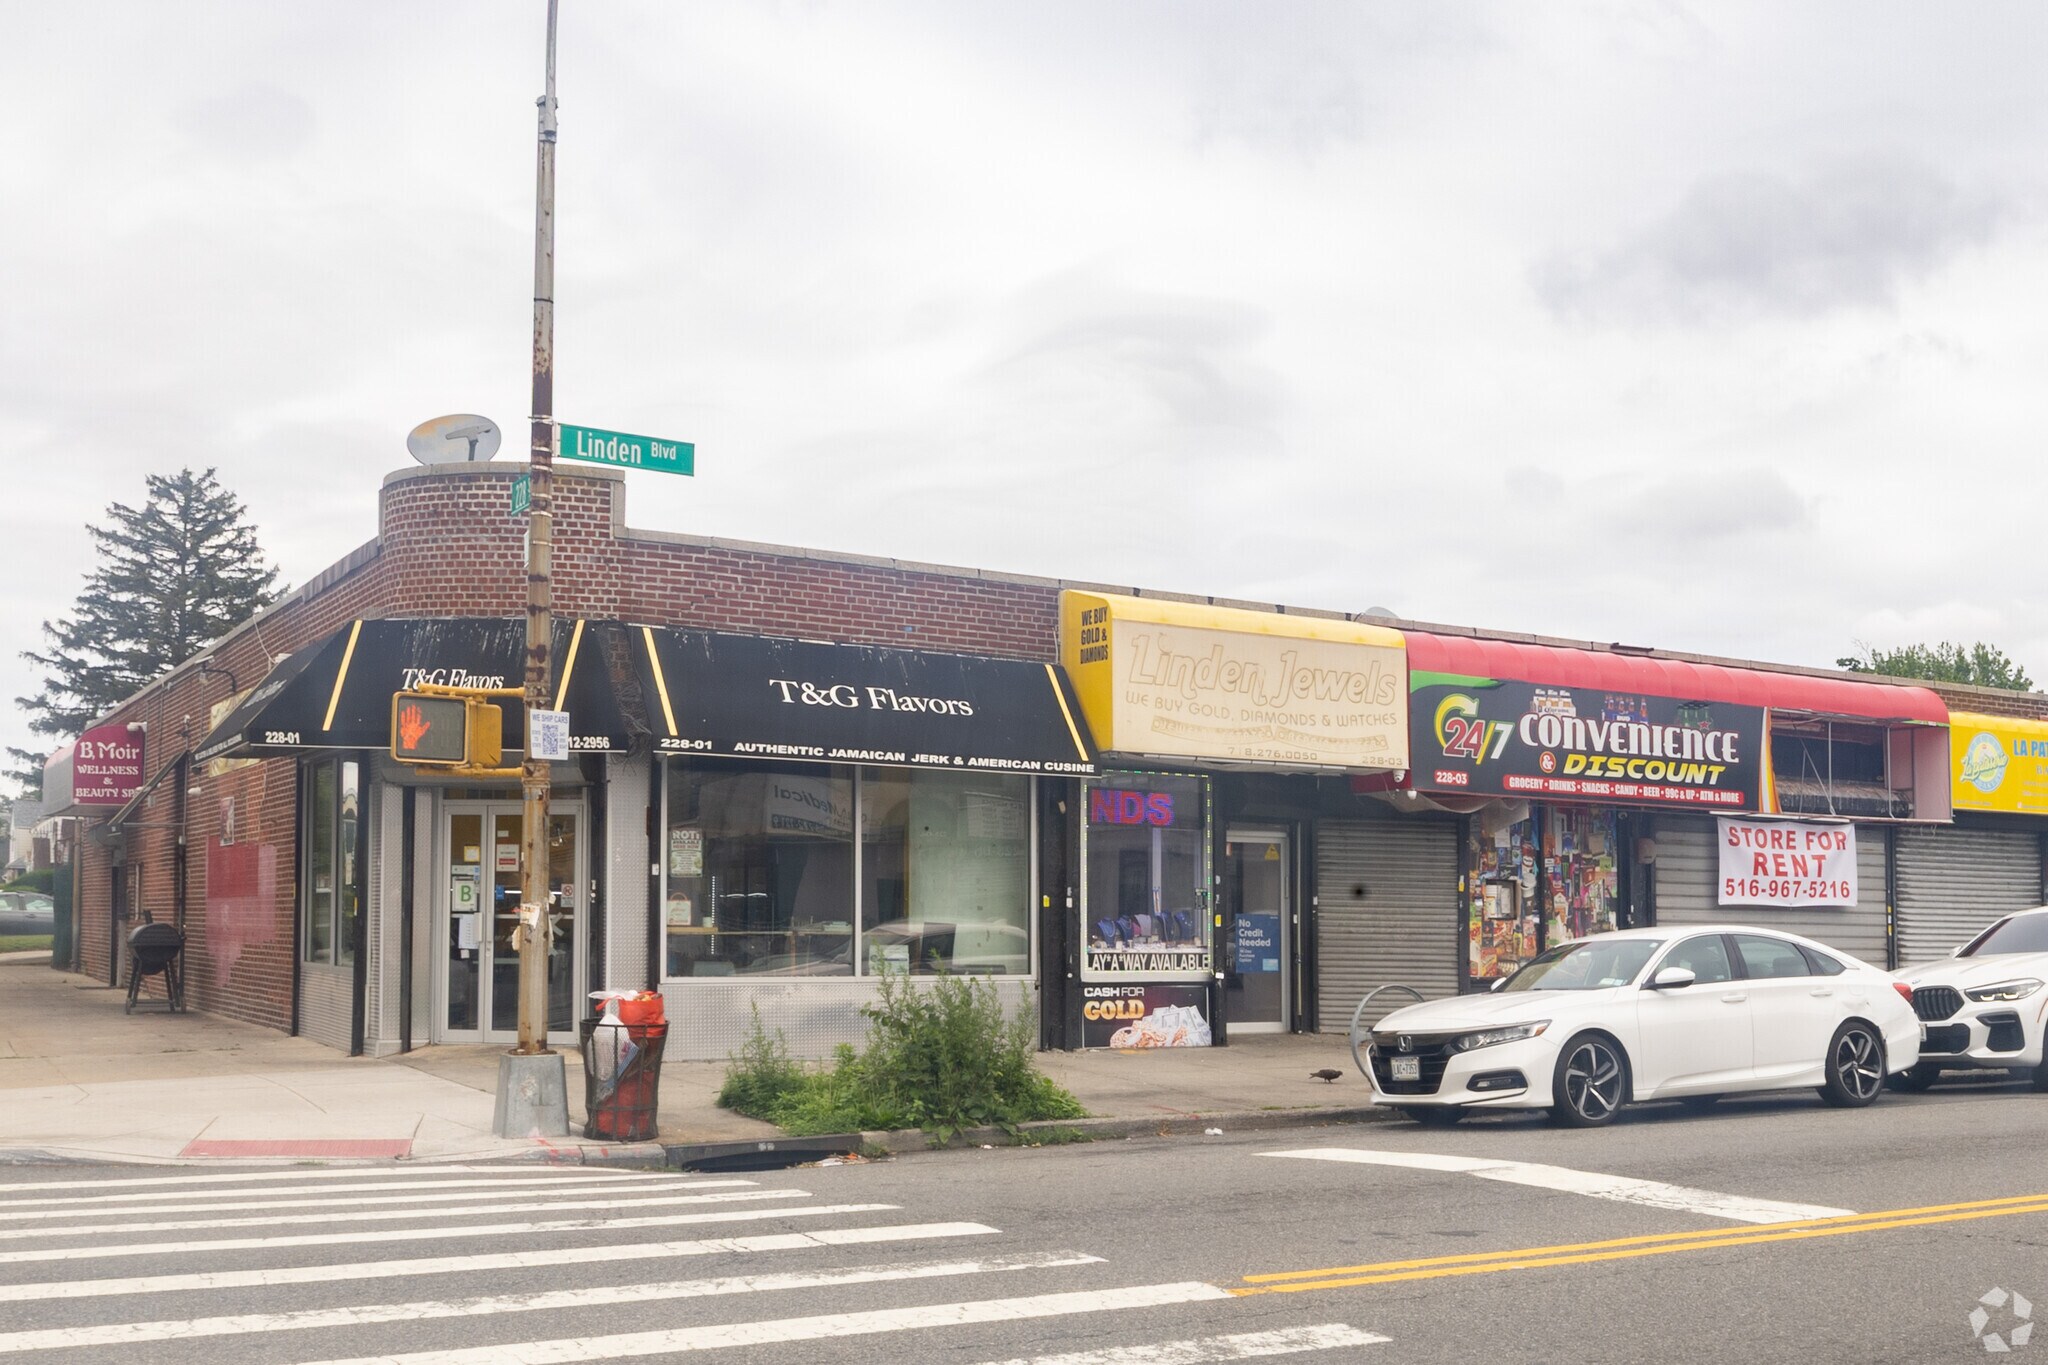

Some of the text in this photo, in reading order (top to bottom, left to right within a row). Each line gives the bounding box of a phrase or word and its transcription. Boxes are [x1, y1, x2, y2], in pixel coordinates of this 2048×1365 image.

[577, 431, 677, 464] Linden Blvd
[1081, 606, 1107, 626] WE BUY
[1081, 627, 1108, 645] GOLD &
[401, 668, 504, 690] T&G Flavors
[1129, 633, 1397, 708] Linden Jewels
[769, 679, 974, 716] T&G Flavors
[1126, 690, 1149, 706] WE
[1155, 697, 1182, 711] BUY
[1241, 709, 1316, 726] DIAMONDS
[1322, 714, 1331, 726] &
[1336, 712, 1397, 727] WATCHES
[554, 715, 569, 724] CARS
[265, 731, 300, 744] 228-01
[568, 736, 610, 749] 12-2956
[1443, 717, 1514, 765] 24/7
[97, 742, 140, 760] Moir
[660, 738, 1095, 774] 228-01 AUTHENTIC JAMAICAN JERK & AMERICAN CUSINE
[2014, 739, 2028, 757] LA
[77, 764, 139, 775] WELLNESS
[1436, 772, 1468, 785] 228-03
[1542, 754, 1726, 785] & DISCOUNT
[103, 777, 113, 785] &
[1509, 776, 1544, 789] GROCERY
[1548, 780, 1576, 792] DRINKS
[1581, 782, 1610, 794] SNACKS
[1615, 784, 1638, 796] CANDY
[1643, 786, 1660, 798] BEER
[1686, 790, 1696, 800] UP
[1700, 791, 1714, 801] ATM
[1720, 792, 1740, 803] MORE
[75, 787, 119, 798] BEAUTY
[1091, 789, 1175, 826] NDS
[1728, 826, 1847, 851] STORE FOR
[1753, 852, 1827, 878] RENT
[461, 885, 471, 902] B
[1725, 878, 1850, 898] 516-967-5216
[1239, 919, 1251, 927] No
[1239, 928, 1263, 937] Credit
[1239, 938, 1271, 946] Needed
[1150, 954, 1210, 971] AVAILABLE
[1084, 987, 1144, 997] CASH FOR
[1083, 999, 1145, 1020] GOLD
